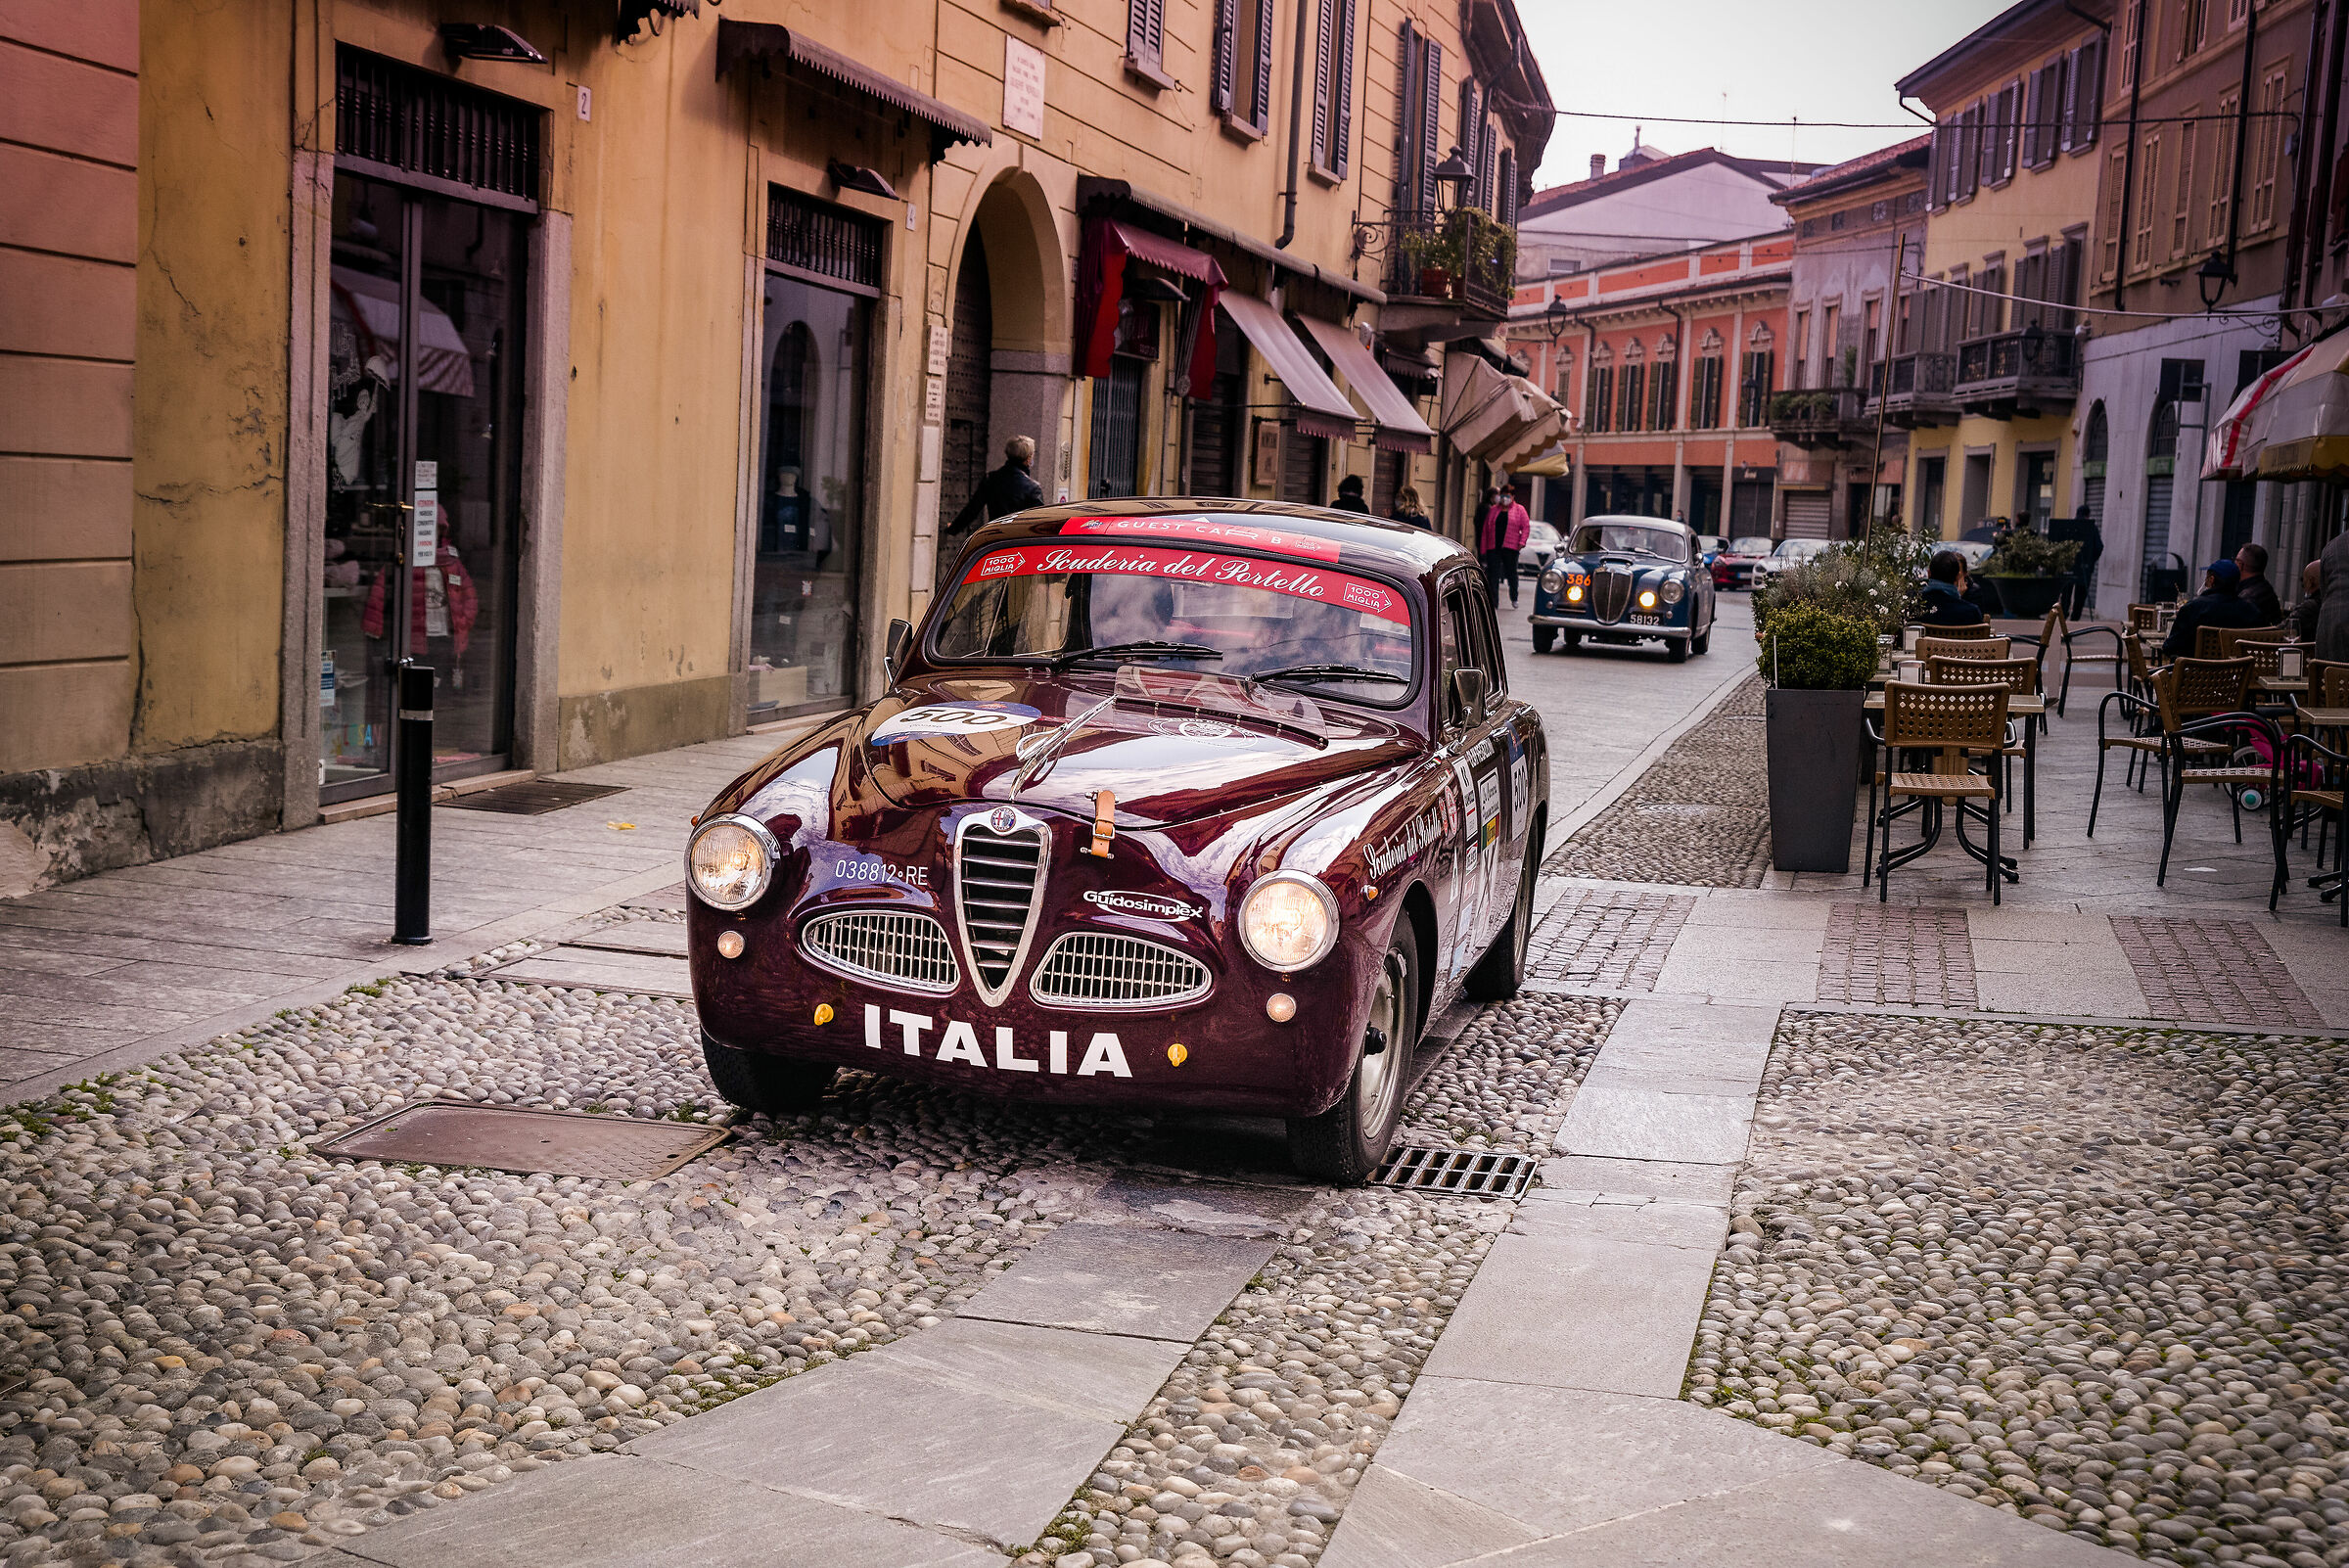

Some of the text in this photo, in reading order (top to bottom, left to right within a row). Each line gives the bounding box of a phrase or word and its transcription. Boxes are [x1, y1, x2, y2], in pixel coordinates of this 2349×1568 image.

[581, 92, 587, 115] 2
[1117, 521, 1184, 530] GUEST
[989, 556, 1015, 566] 1000
[985, 565, 1014, 574] MIGLIA
[1036, 549, 1324, 597] Scuderia del Portello
[1566, 574, 1591, 586] 386
[1350, 586, 1380, 599] 1000
[1347, 593, 1380, 609] MIGLIA
[1630, 614, 1660, 625] 58132
[899, 709, 1007, 725] 500
[1514, 764, 1527, 812] 500
[1362, 836, 1406, 879] Scuderia
[1405, 820, 1418, 856] del
[1415, 807, 1442, 849] Portello
[1082, 890, 1203, 918] Guidosimplex
[864, 1003, 1133, 1078] ITALIA
